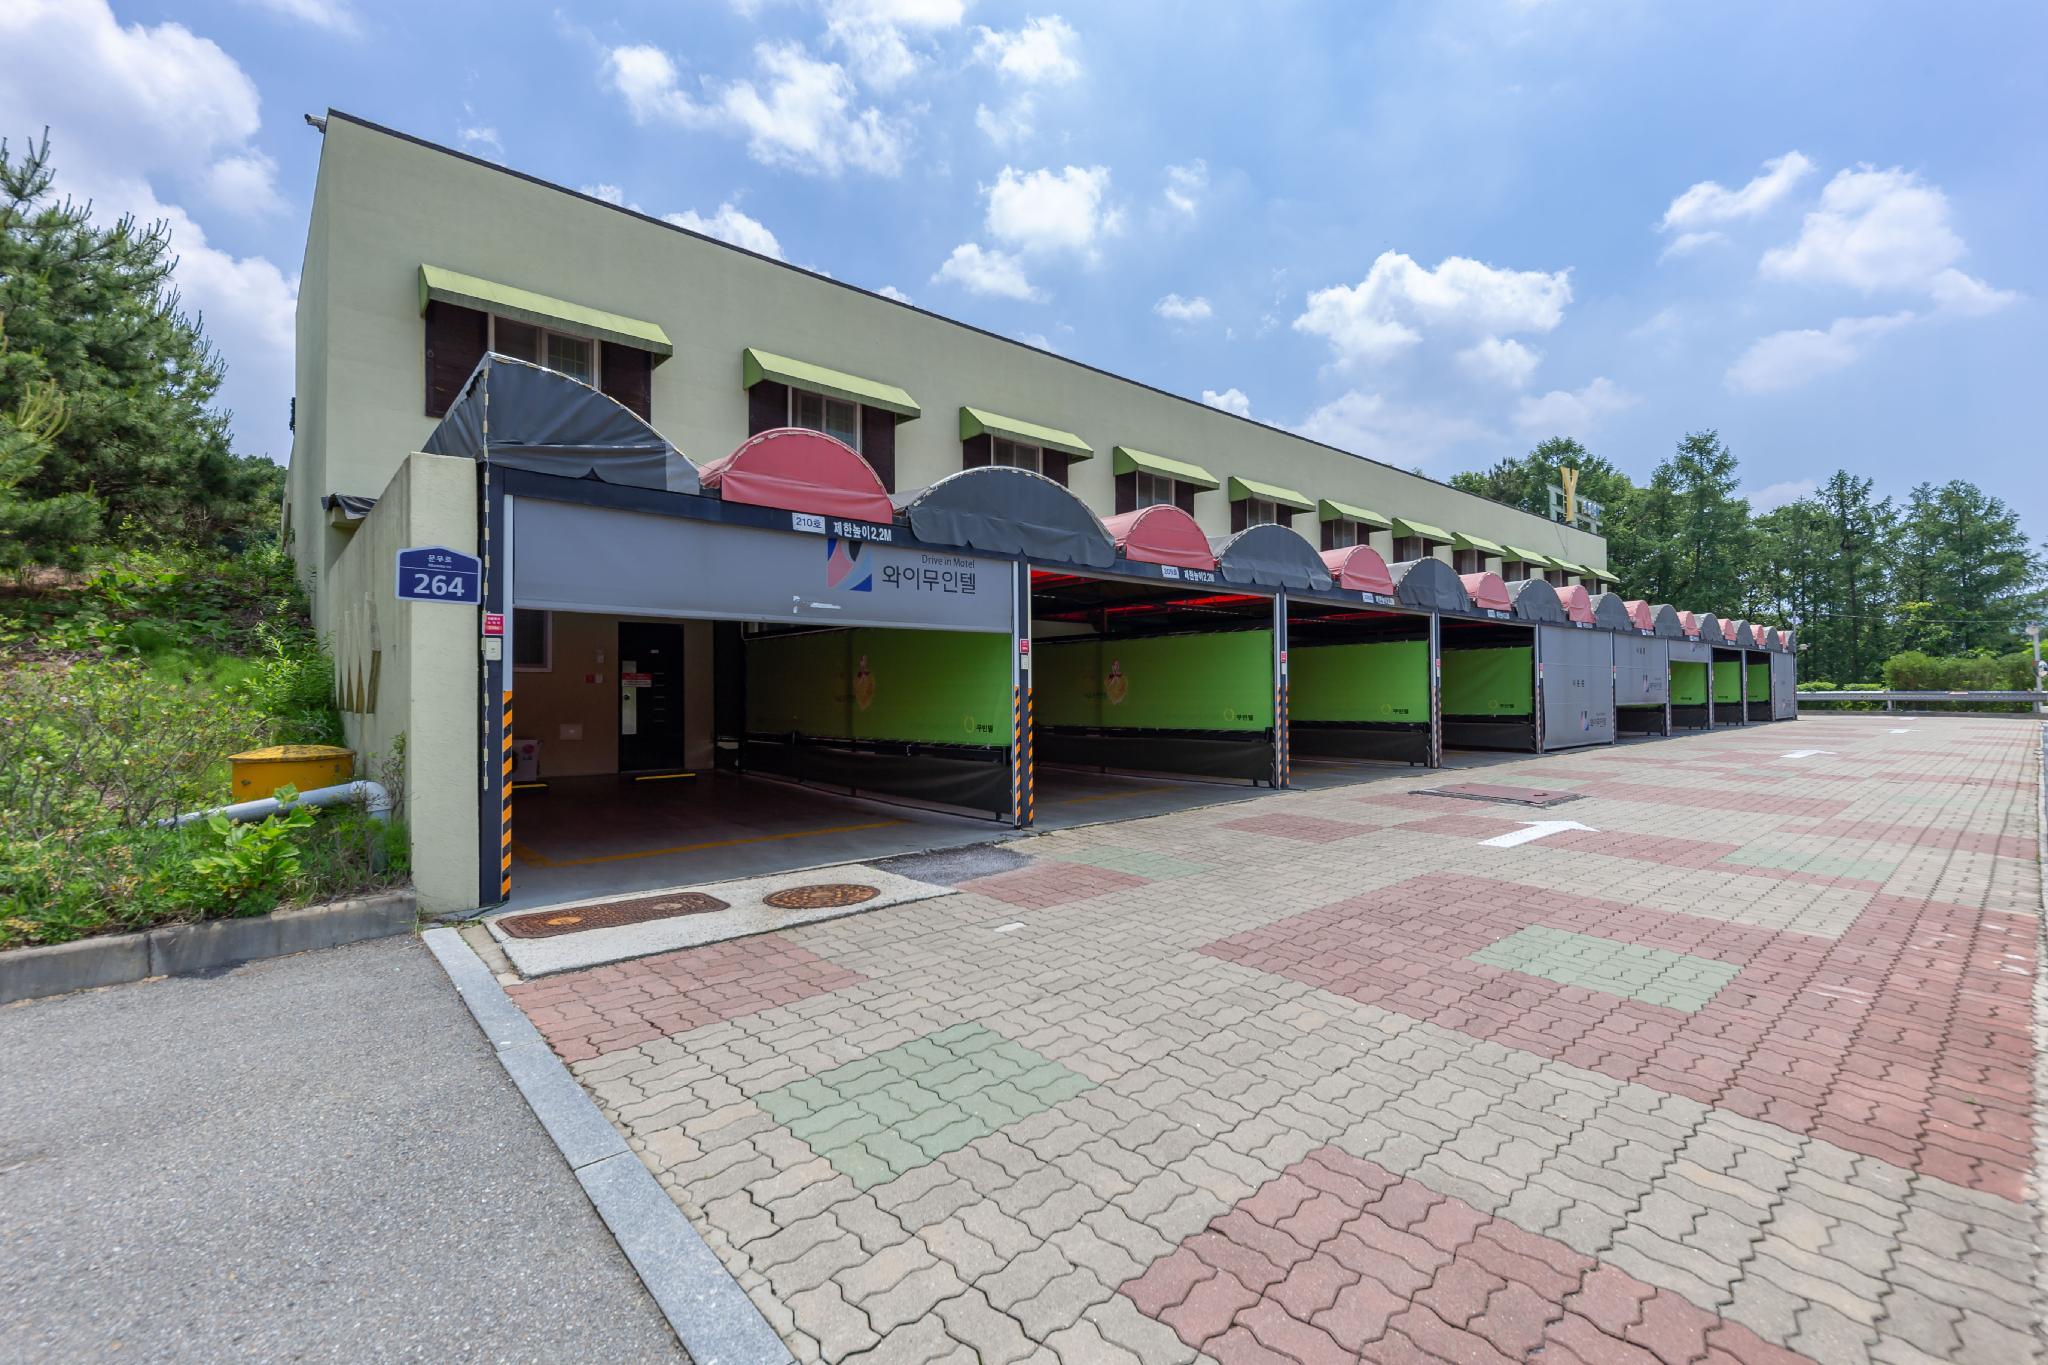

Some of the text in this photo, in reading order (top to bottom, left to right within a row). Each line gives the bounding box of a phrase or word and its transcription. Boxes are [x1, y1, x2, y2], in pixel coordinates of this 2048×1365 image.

[1560, 465, 1579, 522] Y
[796, 516, 822, 529] 210호
[921, 554, 943, 566] Drive
[954, 558, 975, 569] Motel
[413, 573, 465, 597] 264
[882, 565, 976, 595] 와이무인텔
